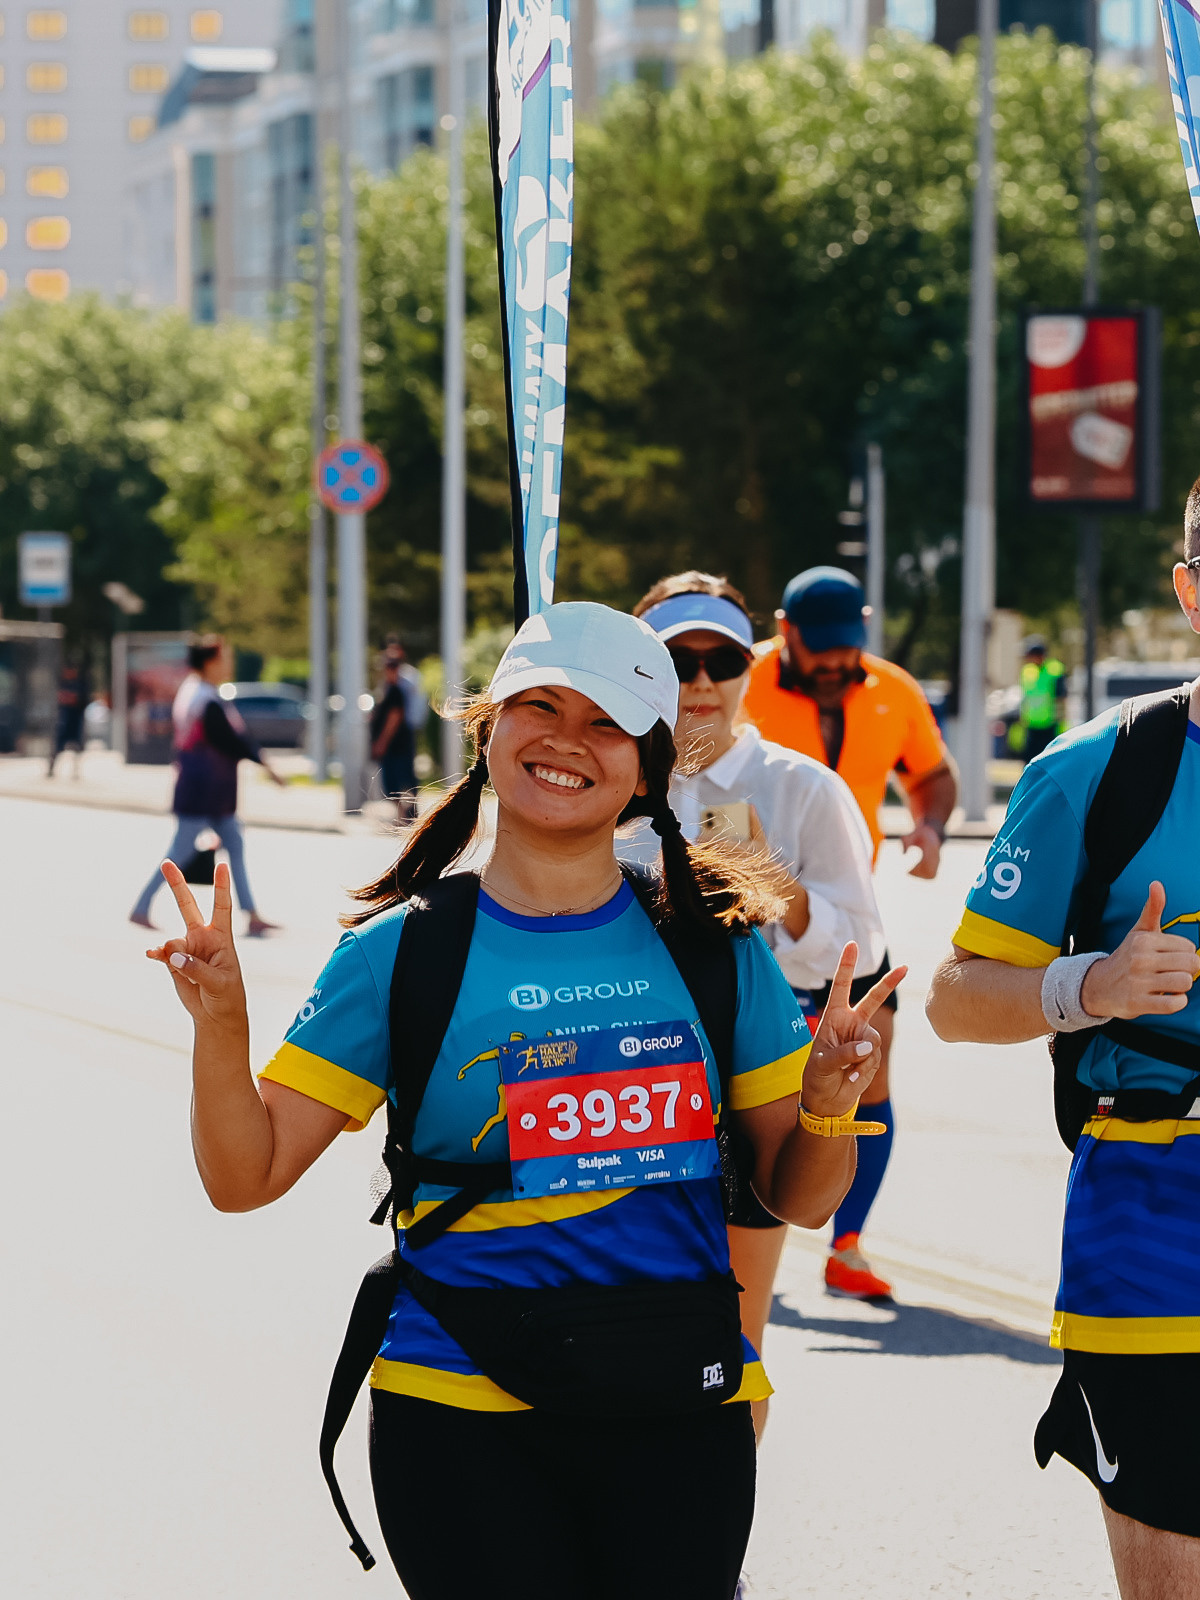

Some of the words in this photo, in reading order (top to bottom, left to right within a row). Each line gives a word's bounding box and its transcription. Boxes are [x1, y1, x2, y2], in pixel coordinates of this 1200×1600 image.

[513, 986, 545, 1008] BI
[554, 980, 650, 1003] GROUP
[540, 1046, 563, 1056] HALF
[643, 1035, 683, 1051] GROUP
[546, 1080, 681, 1142] 3937
[577, 1154, 622, 1171] Sulpak
[635, 1148, 665, 1163] VISA
